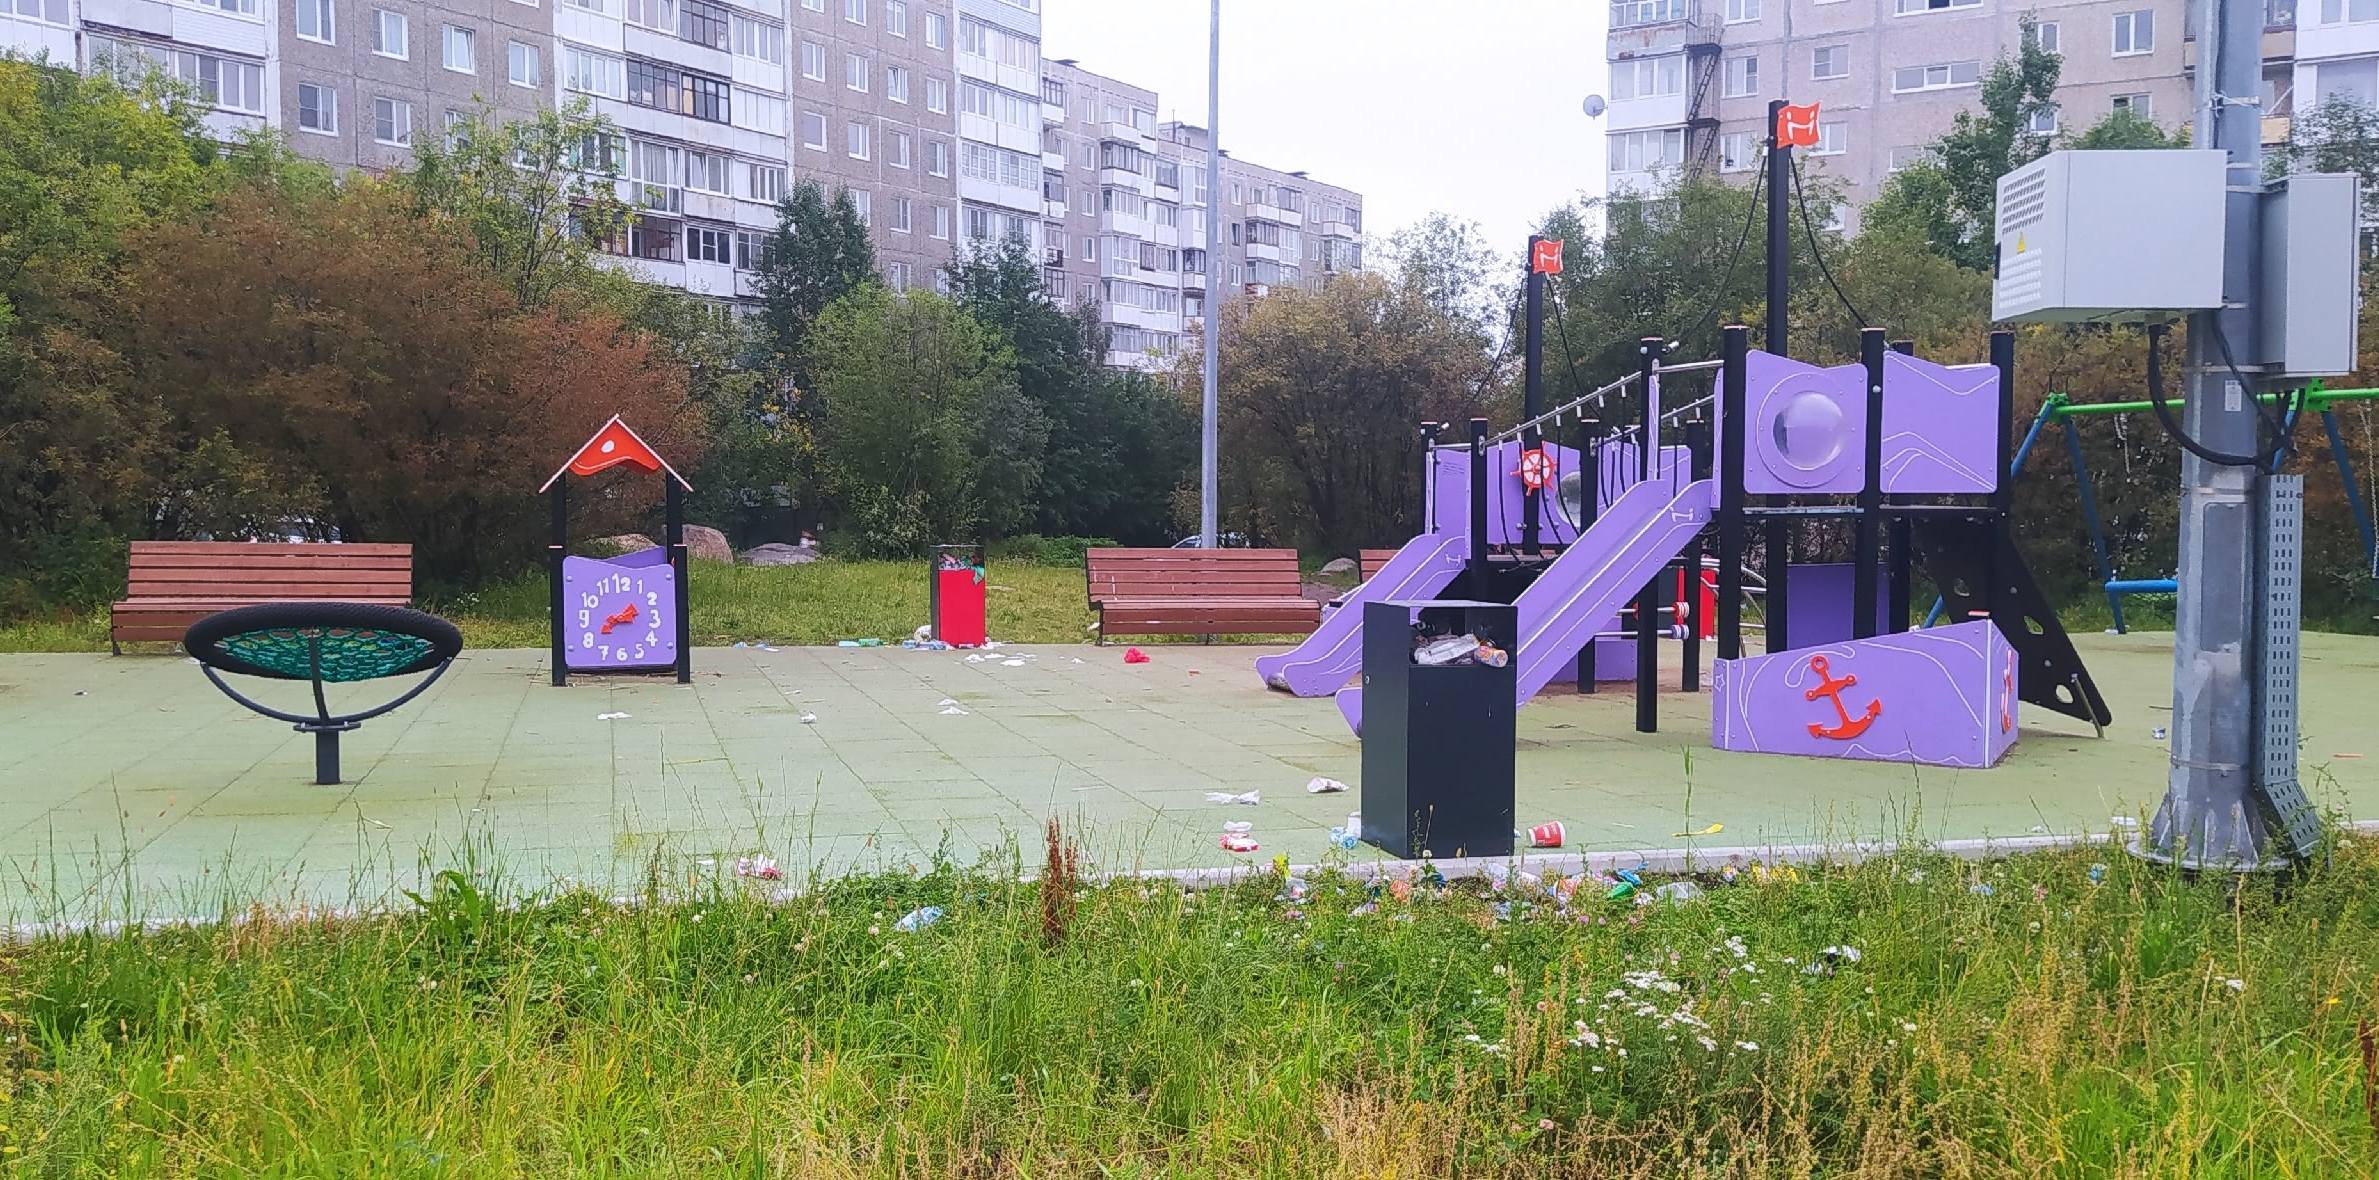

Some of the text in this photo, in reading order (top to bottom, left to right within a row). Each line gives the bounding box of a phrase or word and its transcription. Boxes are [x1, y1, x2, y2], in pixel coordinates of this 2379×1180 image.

[597, 578, 610, 596] 11
[611, 572, 631, 593] 12
[637, 579, 643, 594] 1
[581, 592, 599, 608] 10
[647, 592, 658, 606] 2
[579, 609, 590, 628] 9
[649, 609, 661, 629] 3
[582, 632, 594, 649] 8
[645, 630, 658, 647] 4
[598, 645, 609, 660] 7
[616, 648, 628, 661] 6
[634, 643, 645, 659] 5
